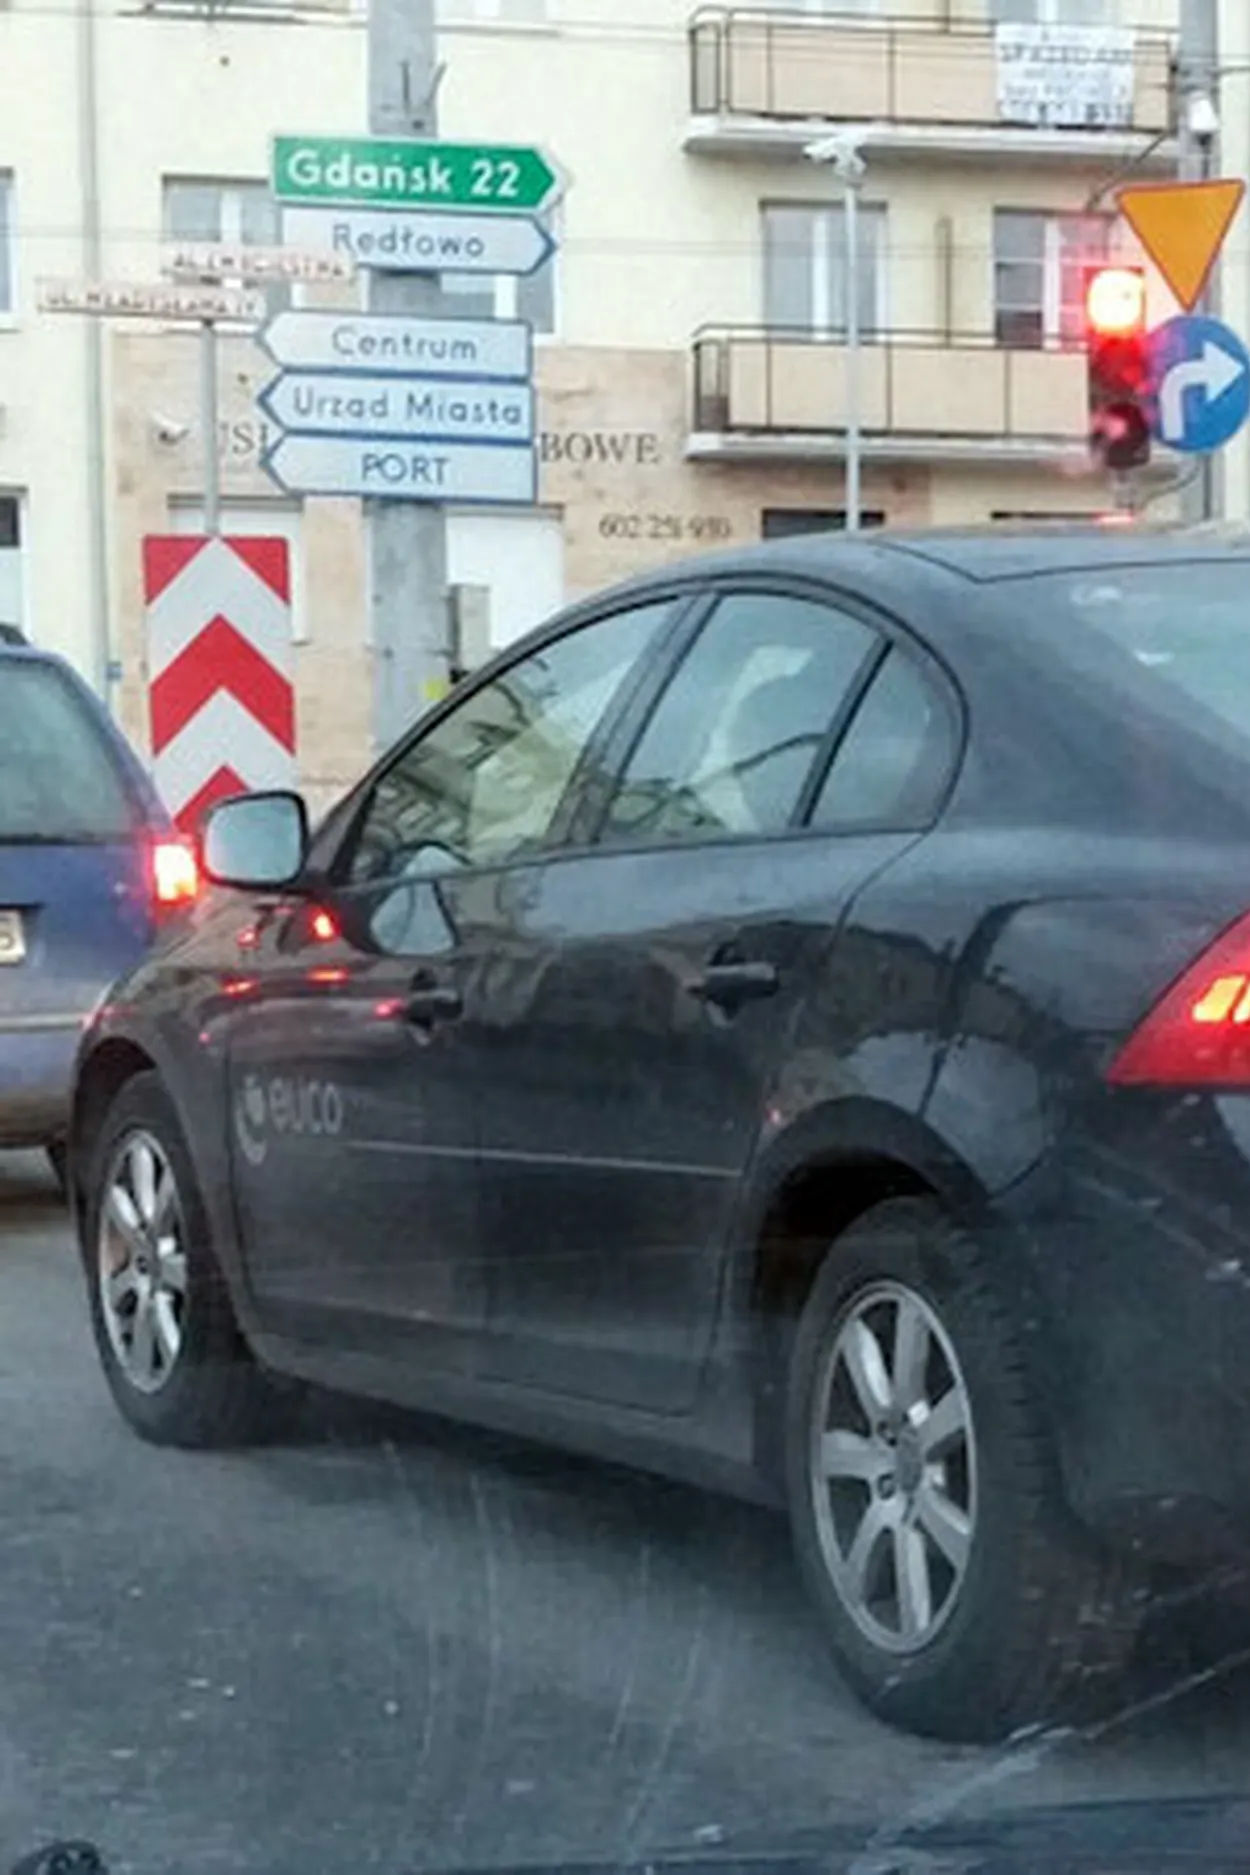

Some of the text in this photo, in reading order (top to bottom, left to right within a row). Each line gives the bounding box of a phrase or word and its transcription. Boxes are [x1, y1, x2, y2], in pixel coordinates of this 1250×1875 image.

[286, 149, 521, 197] Gdańsk 22
[331, 223, 485, 257] Redłowo
[331, 324, 478, 361] Centrum
[405, 393, 521, 426] Miasta
[360, 452, 450, 483] PORT
